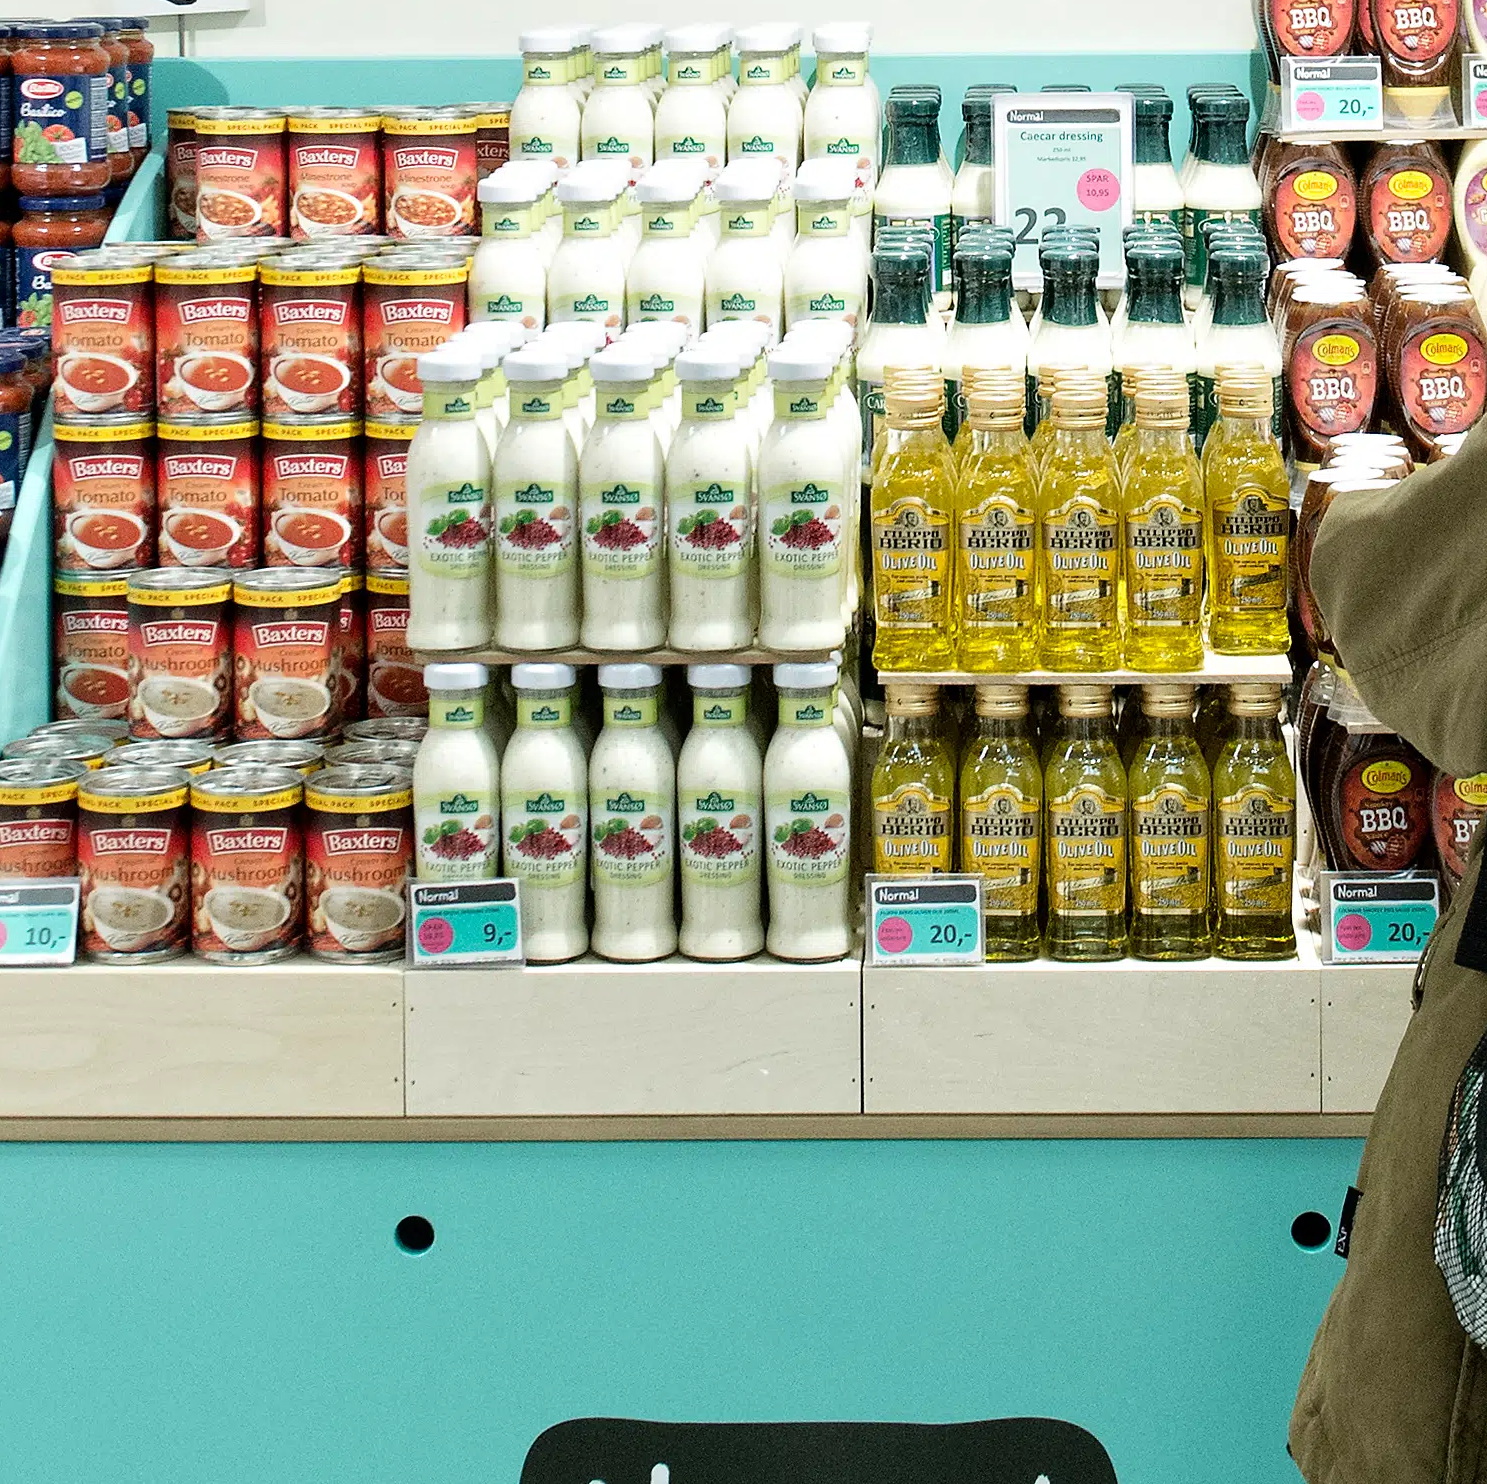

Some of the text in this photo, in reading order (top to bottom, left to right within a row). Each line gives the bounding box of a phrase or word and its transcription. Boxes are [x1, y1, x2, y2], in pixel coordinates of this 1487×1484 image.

[1289, 9, 1333, 29] BBQ
[1394, 7, 1438, 29] BBQ
[1296, 67, 1331, 79] Normal
[1009, 110, 1044, 122] Normal
[1338, 99, 1375, 117] 20,-
[1058, 131, 1104, 143] dressing
[200, 149, 251, 166] Baxters
[299, 149, 356, 166] Baxters
[398, 150, 453, 166] Baxters
[1086, 175, 1109, 183] SPAR
[1298, 179, 1335, 193] Colman's
[1292, 212, 1335, 232] BBQ
[65, 303, 127, 320] Baxters
[184, 302, 247, 319] Baxters
[279, 304, 342, 321] Baxters
[385, 304, 448, 321] Baxters
[64, 333, 123, 347] Tomato
[186, 333, 244, 345] Tomato
[278, 333, 337, 347] Tomato
[1317, 342, 1355, 357] Colman's
[1426, 341, 1463, 357] Colman's
[1310, 377, 1355, 400] BBQ
[1420, 376, 1464, 400] BBQ
[170, 459, 231, 477] Baxters
[279, 488, 339, 503] Tomato
[972, 530, 1028, 538] FILIPPO
[880, 538, 942, 549] BERIO
[967, 537, 1030, 549] BERIO
[882, 553, 937, 570] OLIVE OIL
[970, 553, 1025, 570] OLIVE OIL
[146, 624, 213, 644] Baxters
[1367, 769, 1408, 784] Colman's
[975, 817, 1031, 825] FILIPPO
[1360, 807, 1408, 833] BBQ
[971, 825, 1033, 836] BERIO
[95, 833, 165, 851] Baxters
[213, 833, 282, 851] Baxters
[974, 840, 1028, 857] OLIVE OIL
[418, 889, 459, 903] Normal
[879, 888, 919, 901] Normal
[1337, 884, 1377, 898] Normal
[25, 928, 66, 949] 10,-
[483, 923, 512, 946] 9,-
[930, 925, 972, 947] 20,-
[1388, 923, 1430, 946] 20,-
